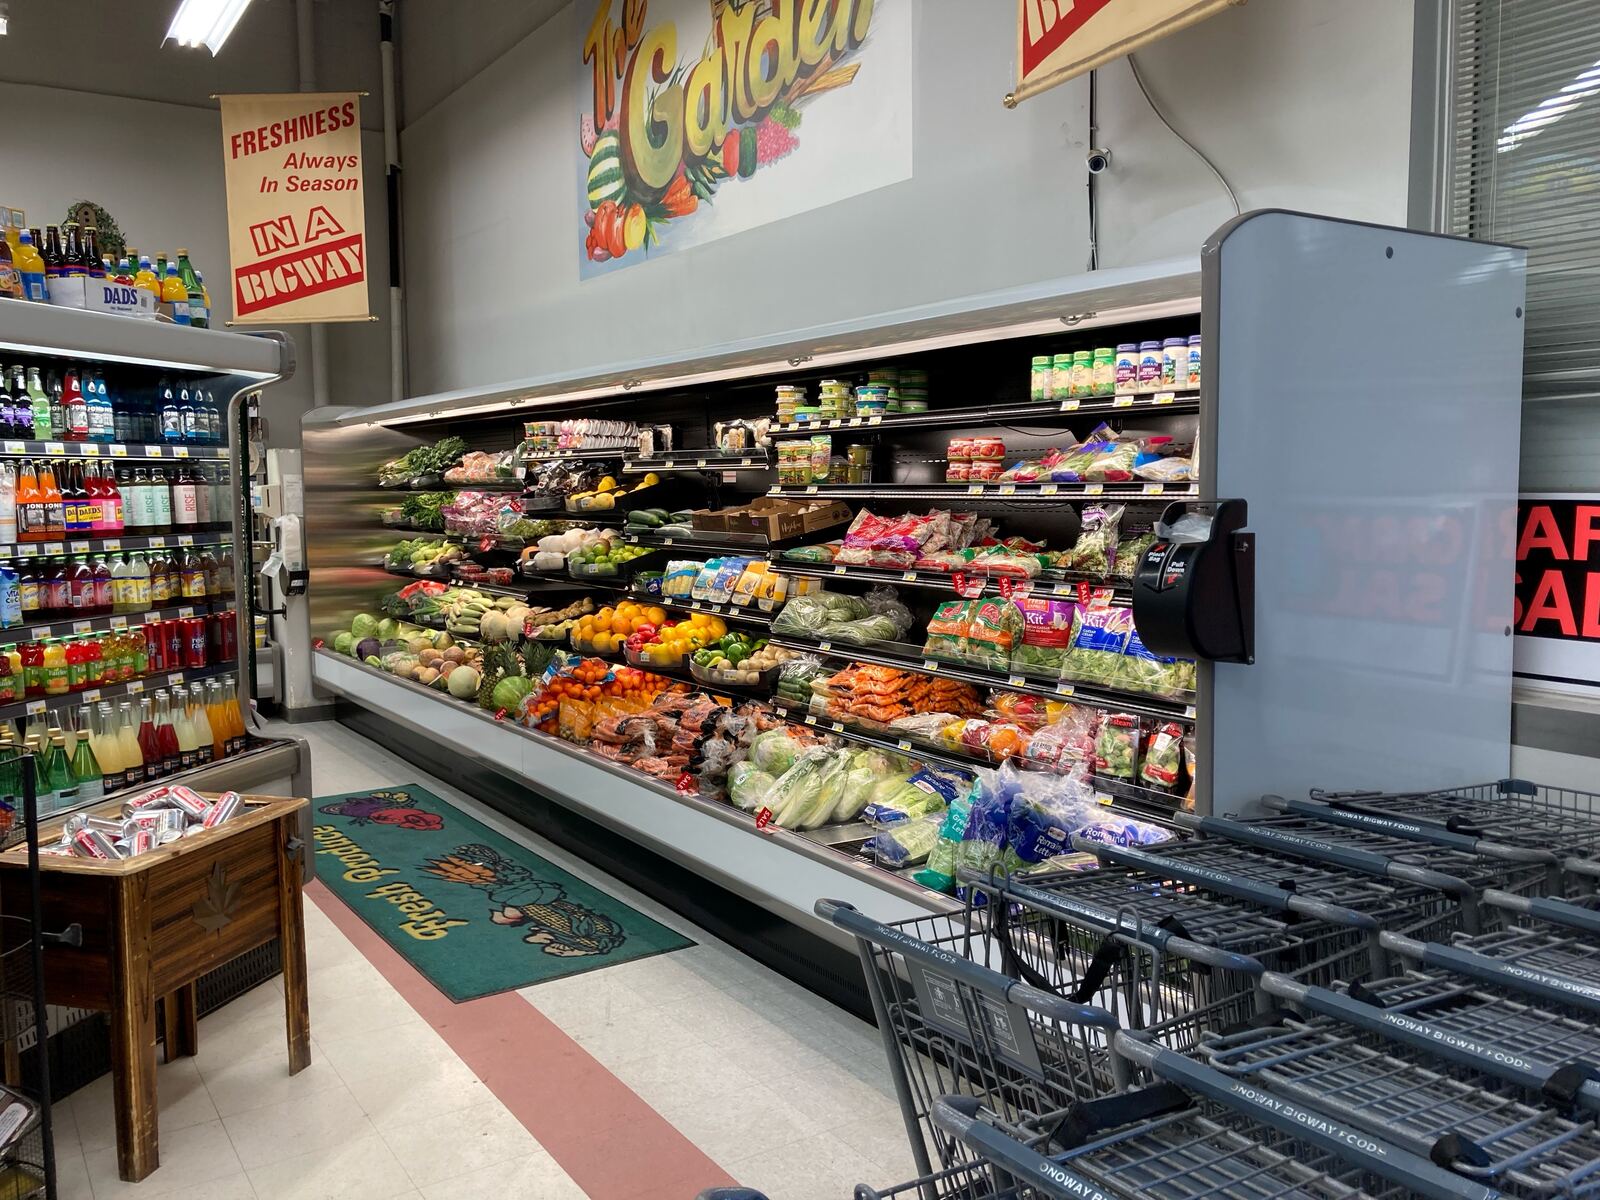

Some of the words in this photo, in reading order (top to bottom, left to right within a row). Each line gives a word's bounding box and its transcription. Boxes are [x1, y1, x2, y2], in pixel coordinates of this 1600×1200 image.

[620, 0, 875, 190] Garden
[231, 101, 355, 159] FRESHNESS
[283, 153, 358, 174] Always
[260, 176, 279, 193] In
[285, 176, 358, 193] Season
[249, 215, 300, 258] IN
[304, 205, 345, 243] A
[237, 244, 362, 304] BIGWAY
[185, 494, 195, 511] RISE
[955, 574, 965, 594] SALE
[1001, 577, 1010, 597] SALE
[1079, 584, 1089, 604] SALE
[1026, 612, 1044, 625] Kit
[1086, 614, 1105, 628] Kit
[678, 774, 691, 790] SALE
[757, 810, 770, 827] SALE
[1363, 816, 1393, 827] BIGWAY
[1393, 822, 1420, 833] FOODS
[1086, 827, 1126, 844] Romaine
[365, 880, 469, 941] Fresh
[1433, 1030, 1484, 1056] BIGWAY
[1283, 1105, 1337, 1135] BIGWAY
[1039, 1162, 1093, 1198] ONOWAY
